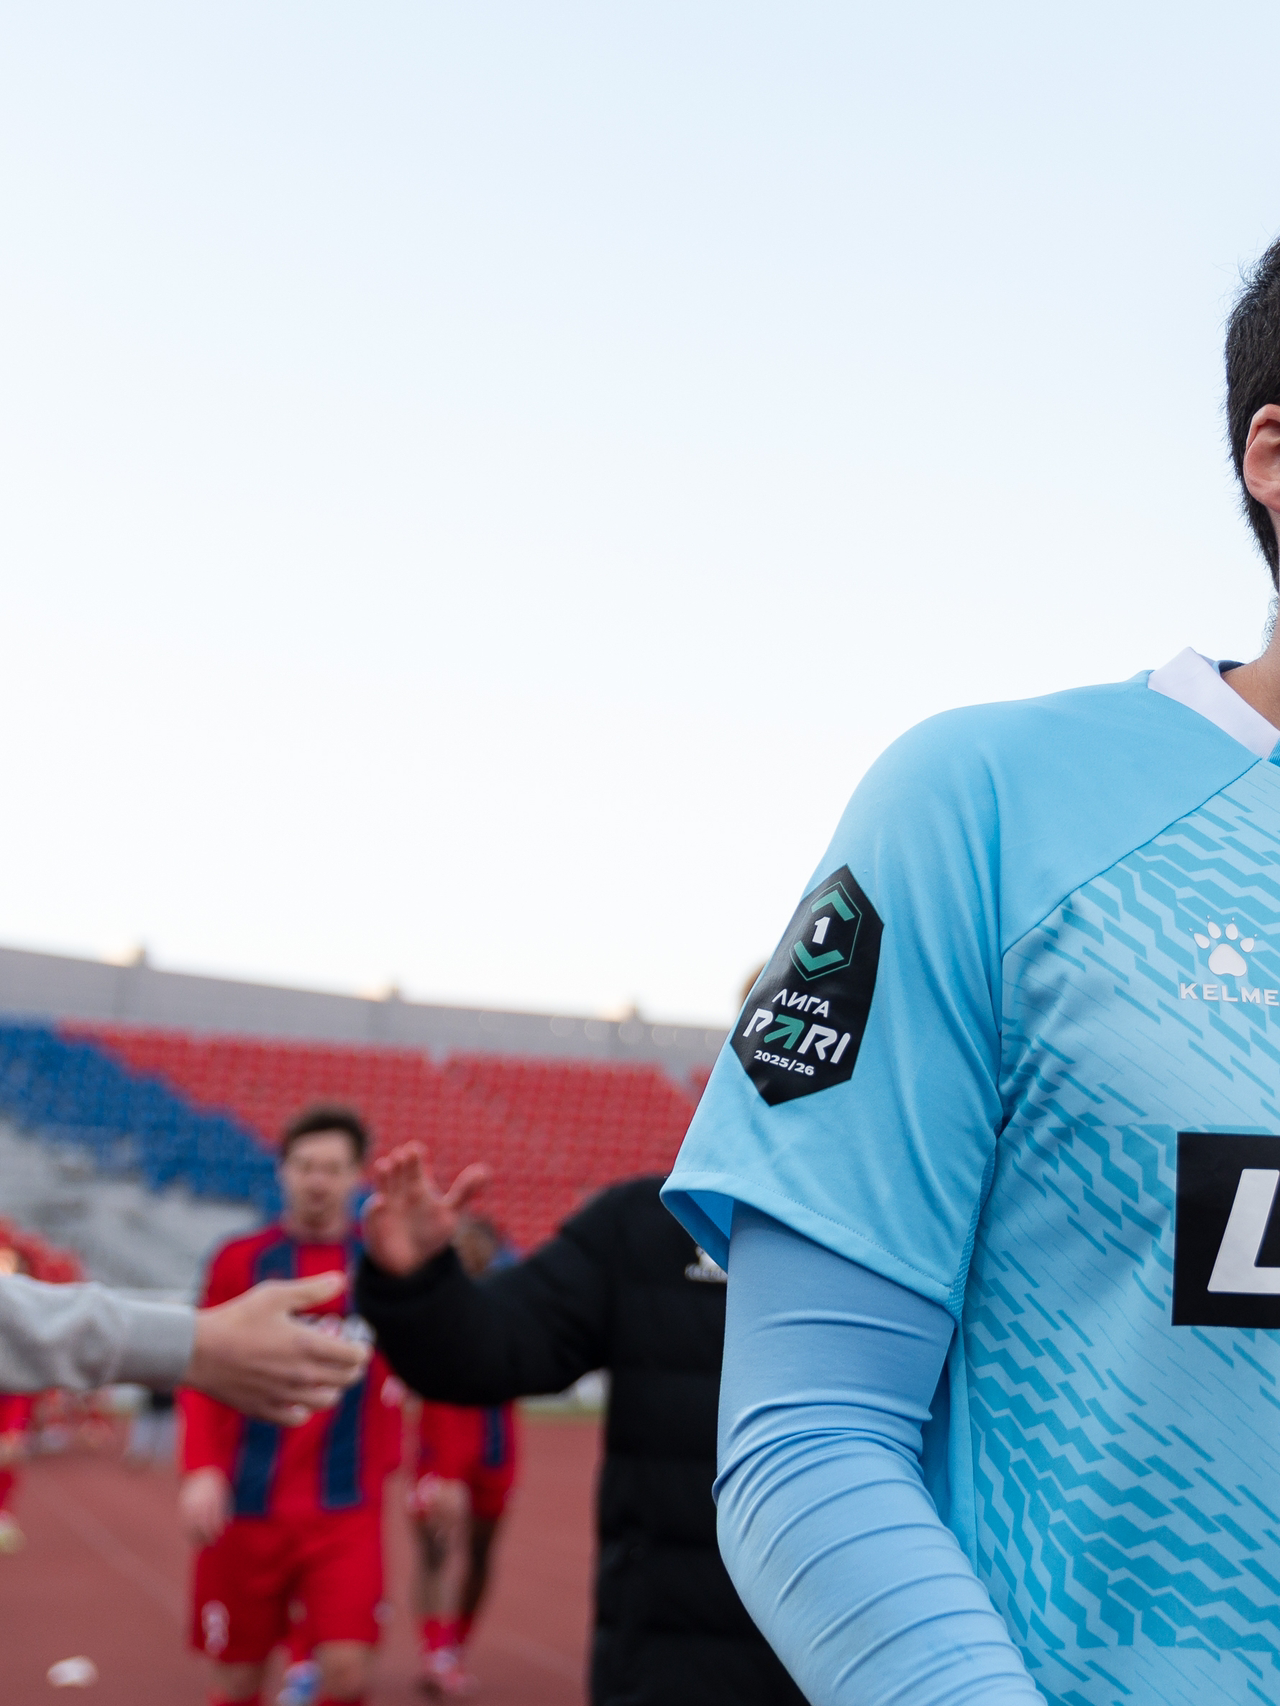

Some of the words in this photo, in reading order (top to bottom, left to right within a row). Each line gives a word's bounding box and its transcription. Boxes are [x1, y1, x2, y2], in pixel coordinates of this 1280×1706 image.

[811, 916, 831, 945] 1
[771, 988, 830, 1018] ЛИГА
[1180, 982, 1280, 1006] KELME
[742, 1007, 851, 1064] PARI
[753, 1050, 815, 1076] 2025/26
